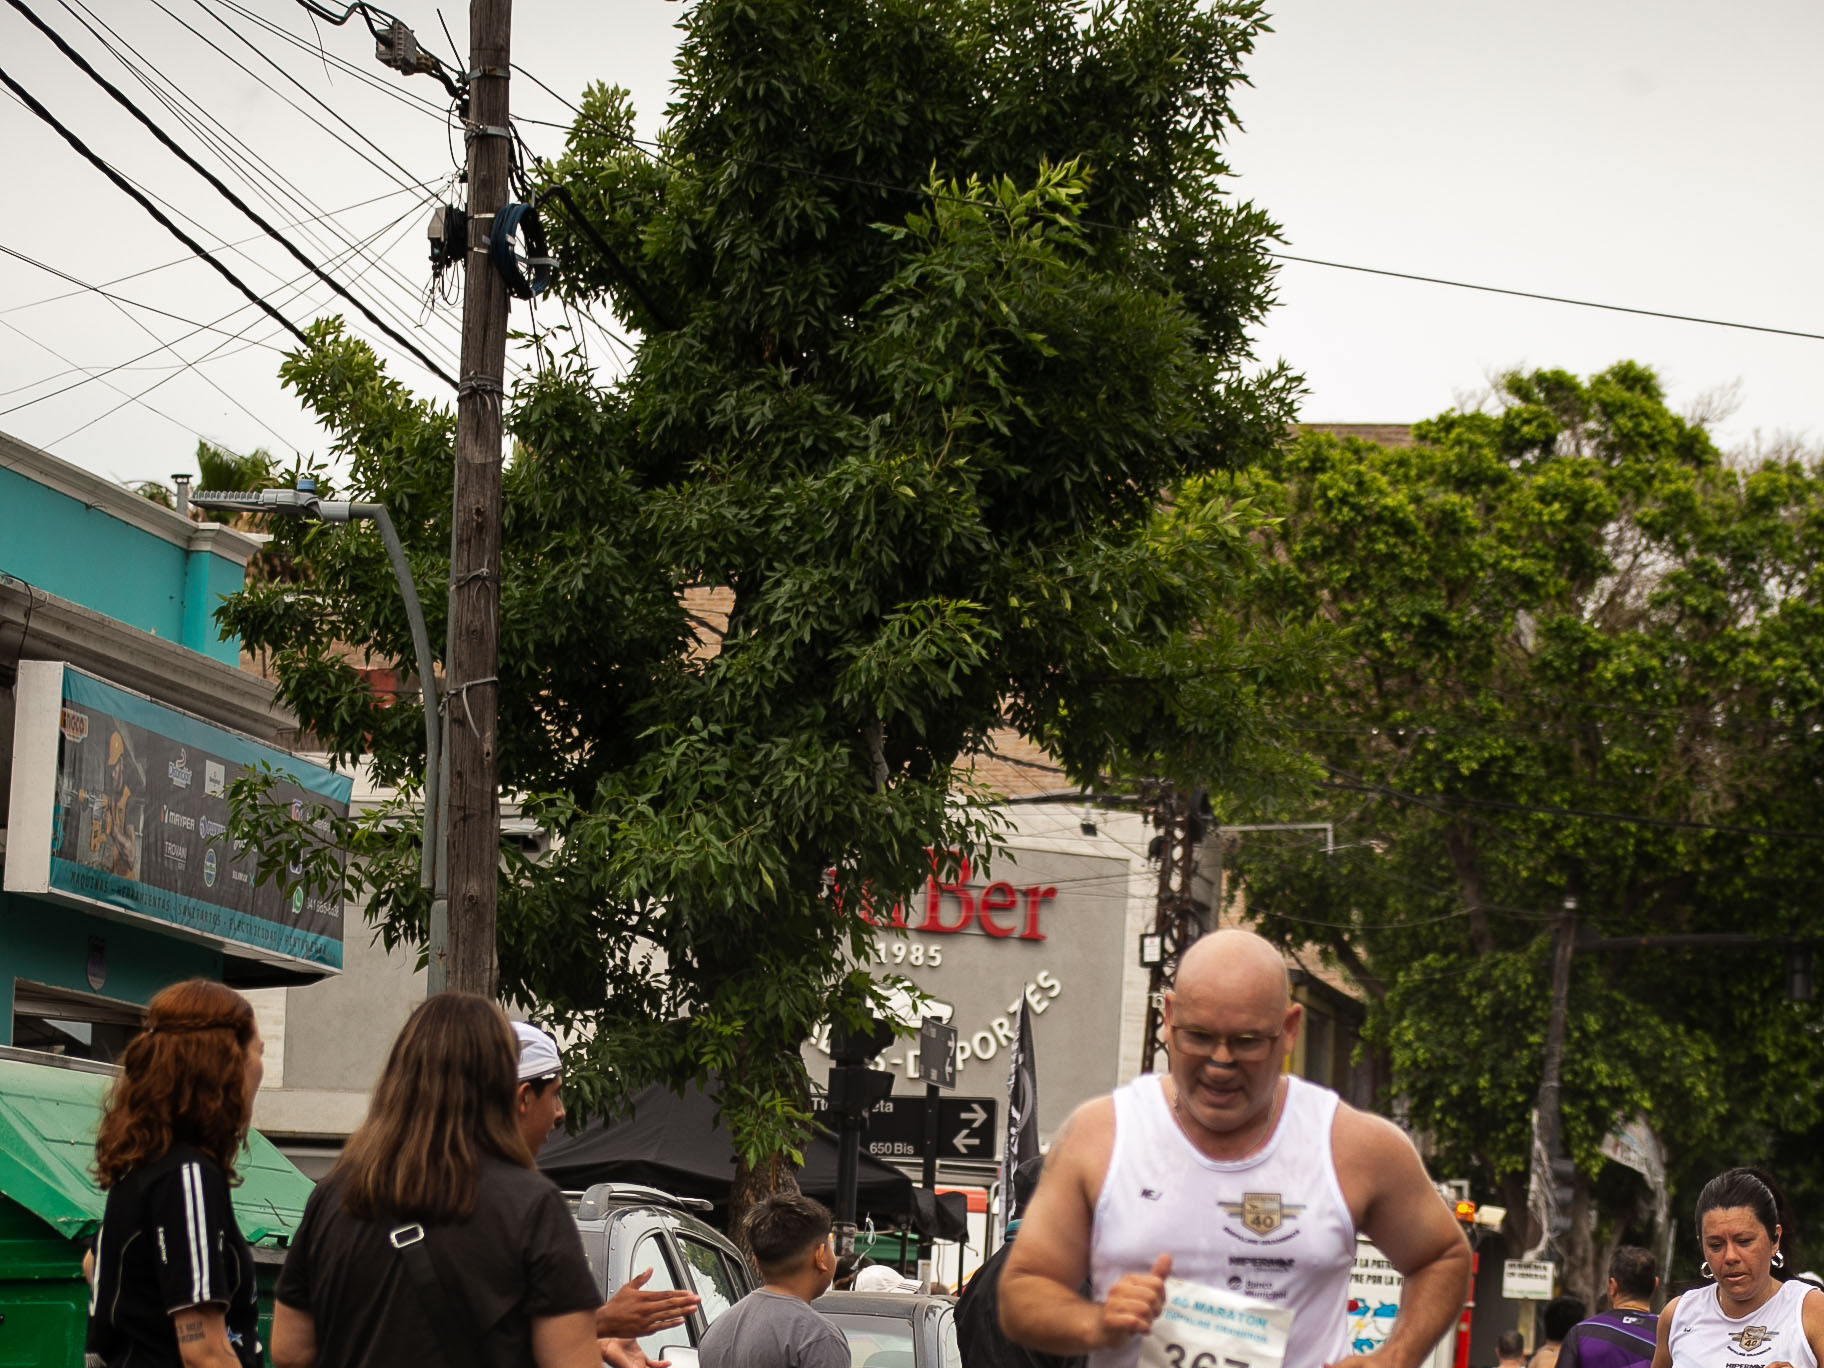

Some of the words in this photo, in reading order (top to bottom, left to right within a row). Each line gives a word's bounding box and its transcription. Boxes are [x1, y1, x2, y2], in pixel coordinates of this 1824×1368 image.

[169, 811, 195, 831] MAYPER
[874, 941, 942, 968] 1985
[869, 1142, 893, 1155] 650
[893, 1142, 915, 1155] Bis
[1250, 1215, 1274, 1230] 40
[1744, 1339, 1758, 1347] 40
